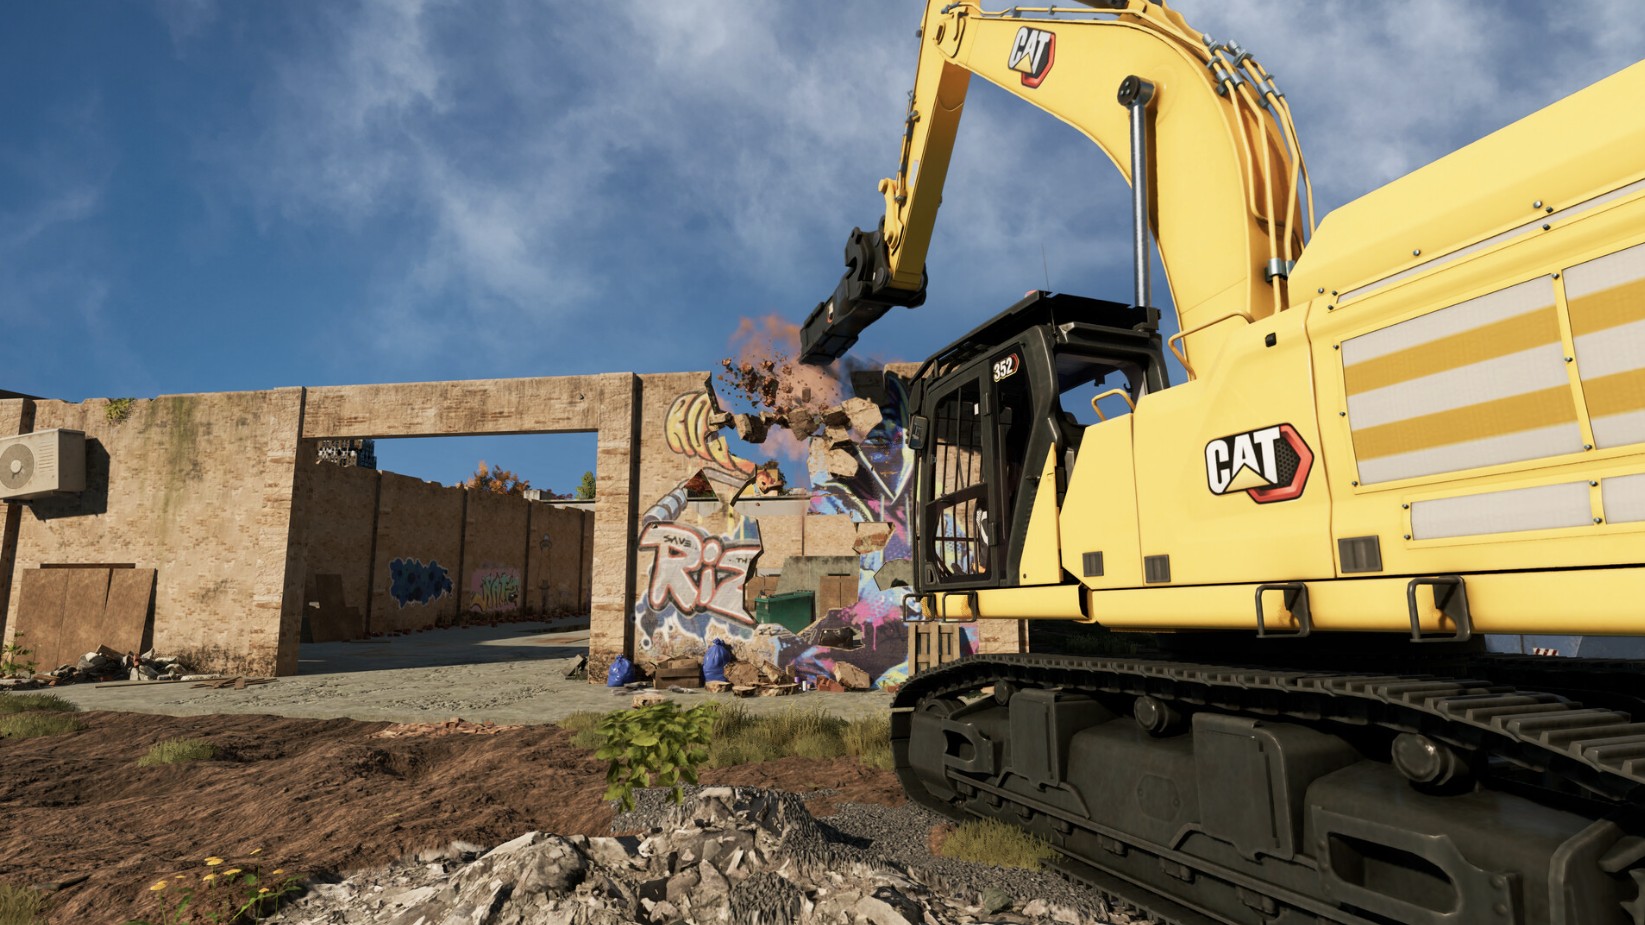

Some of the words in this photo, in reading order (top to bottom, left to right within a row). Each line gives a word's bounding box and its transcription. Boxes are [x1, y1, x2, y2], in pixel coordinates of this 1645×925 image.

[1008, 26, 1052, 75] CAT
[993, 356, 1013, 380] 352
[1205, 425, 1280, 494] CAT
[663, 535, 692, 547] SAVE
